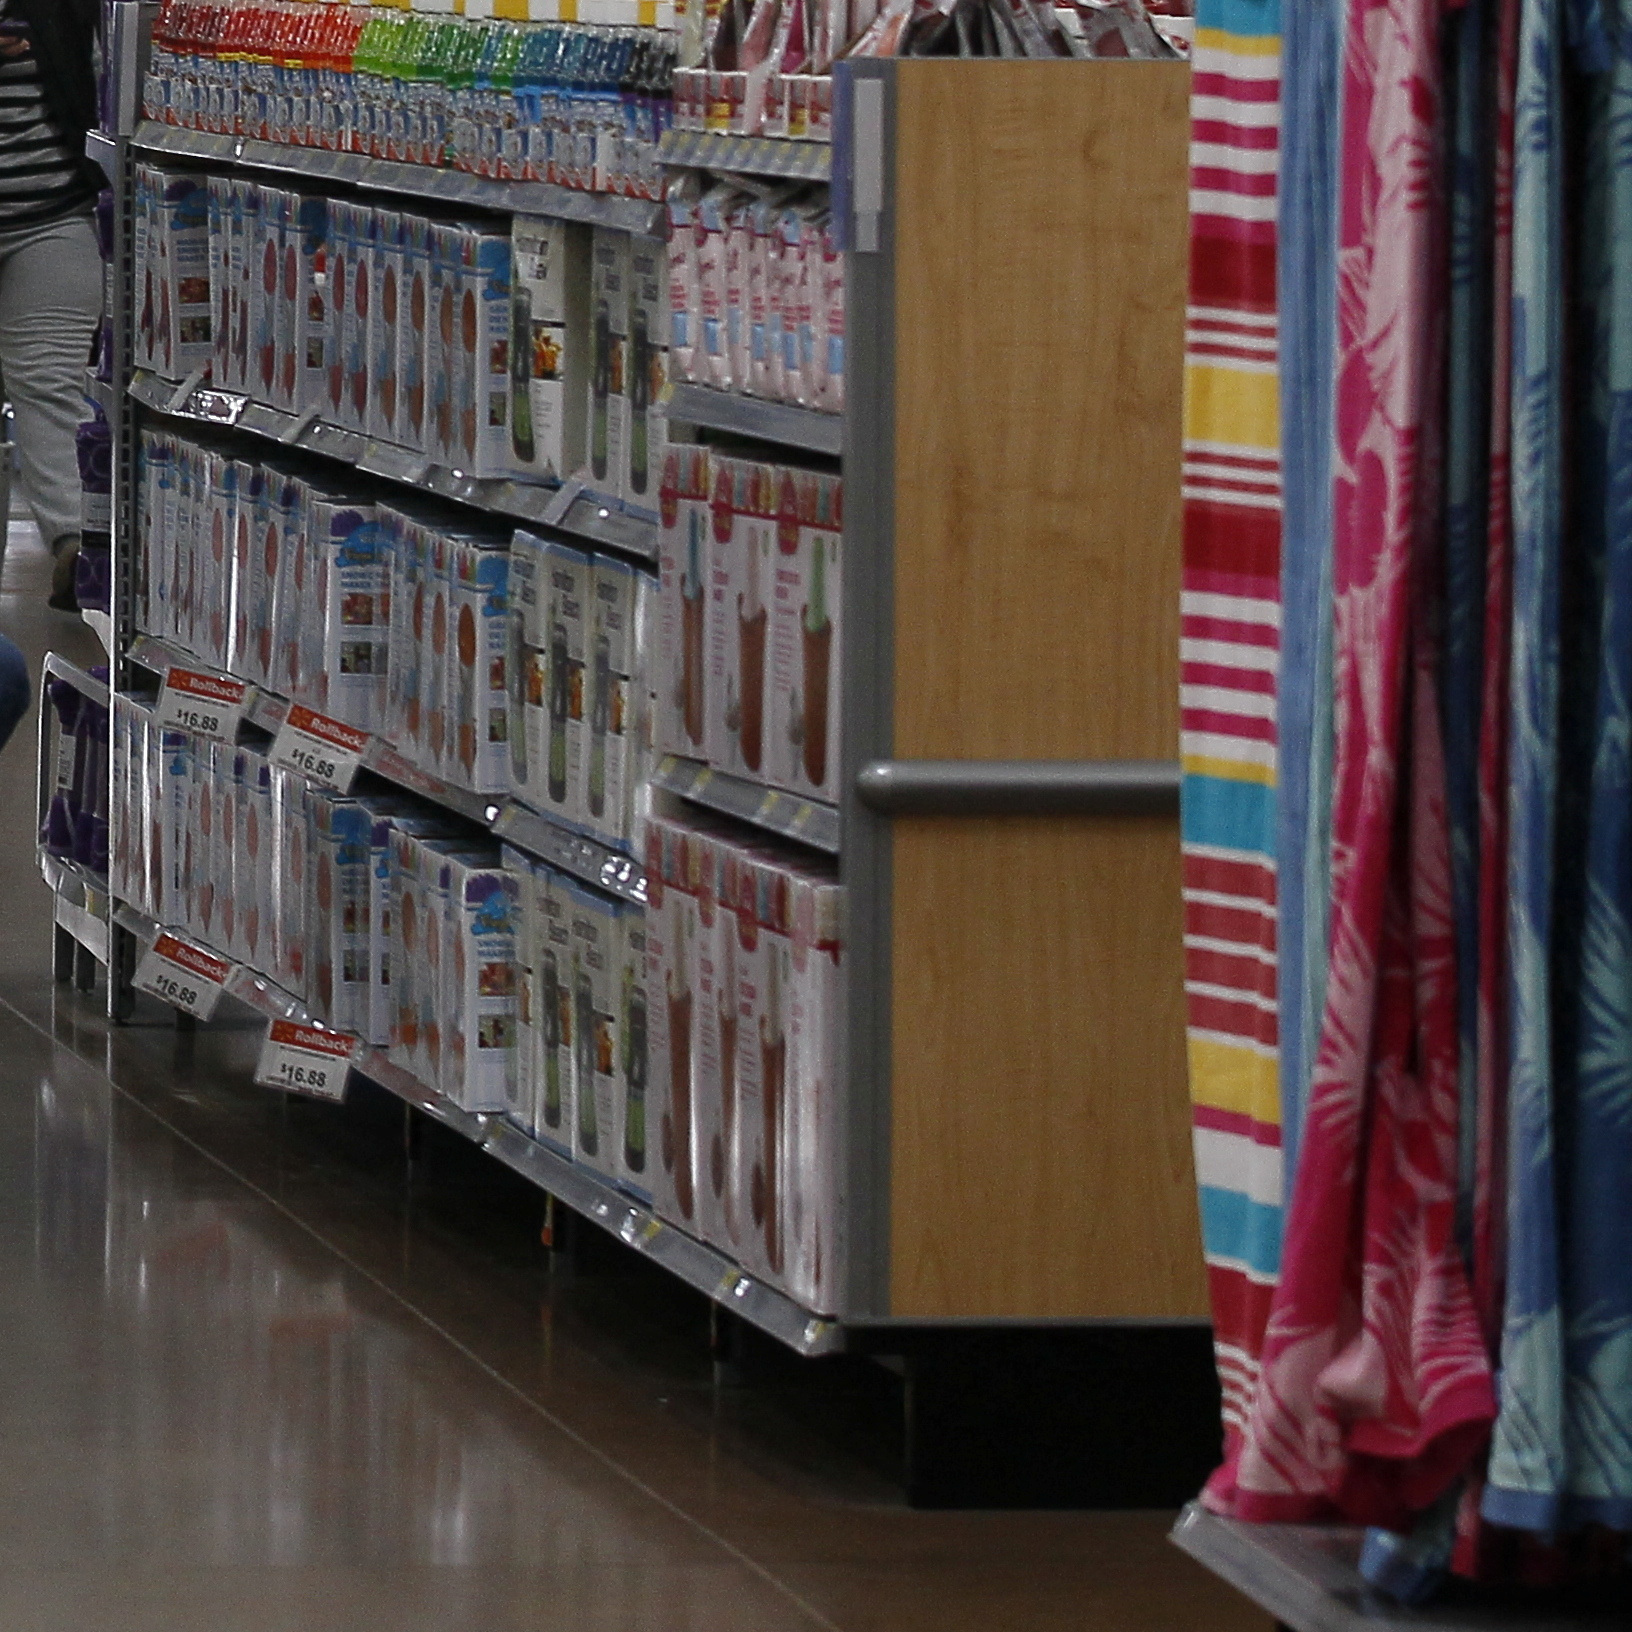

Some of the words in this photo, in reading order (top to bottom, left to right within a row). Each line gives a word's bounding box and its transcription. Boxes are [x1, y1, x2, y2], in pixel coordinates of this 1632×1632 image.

[188, 676, 242, 700] Rollback
[176, 708, 219, 733] $16.88
[309, 717, 363, 747] Rollback
[291, 747, 336, 779] $16.88
[175, 945, 226, 980] Rollback
[156, 973, 198, 1006] $16.88
[293, 1028, 354, 1054] Rollback
[280, 1061, 327, 1088] $16.88
